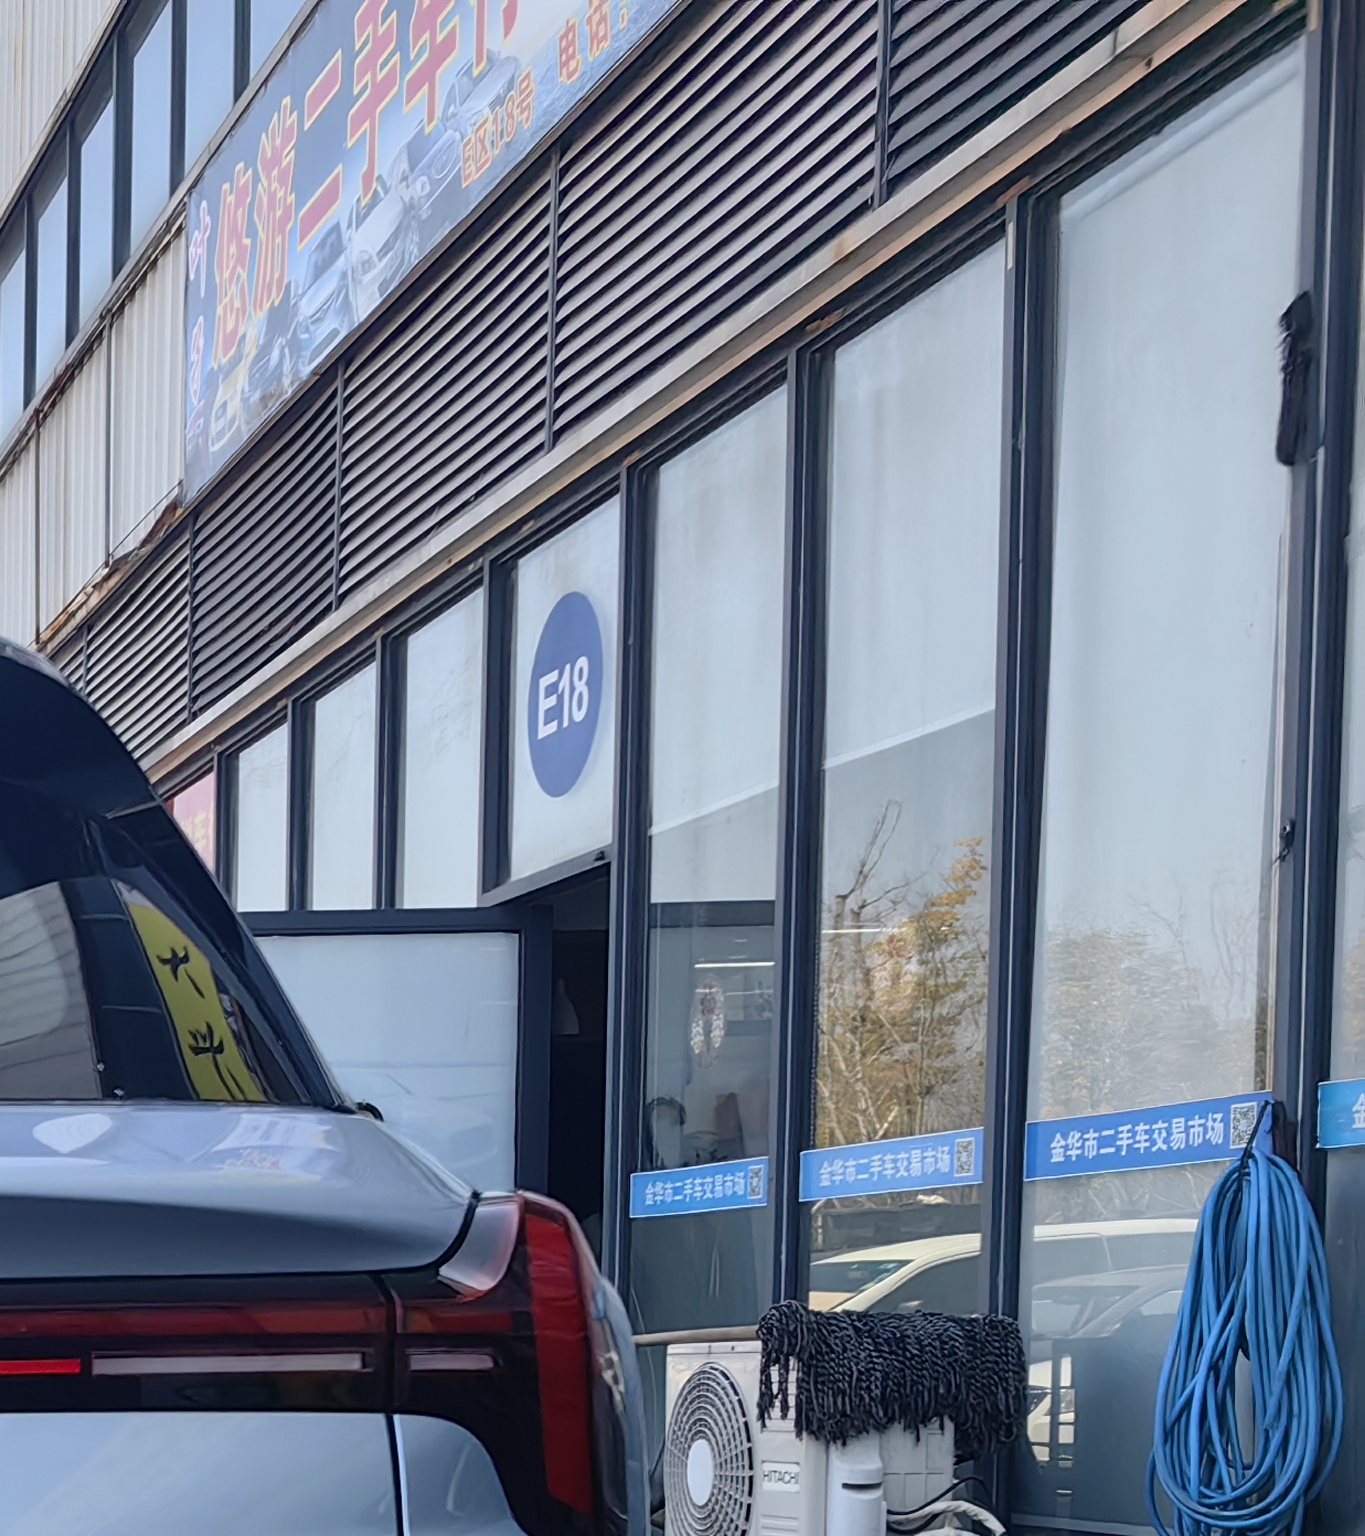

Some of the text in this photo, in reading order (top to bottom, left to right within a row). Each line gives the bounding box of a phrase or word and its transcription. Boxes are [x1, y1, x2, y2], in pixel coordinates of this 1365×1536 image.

[461, 68, 535, 188] E区18号
[537, 656, 589, 740] E18
[1050, 1113, 1224, 1162] 金华市二手车交易市场
[645, 1171, 745, 1206] 金华市二手车交易市场
[819, 1146, 951, 1187] 金华市二手车交易市场
[762, 1470, 799, 1485] HITACHI
